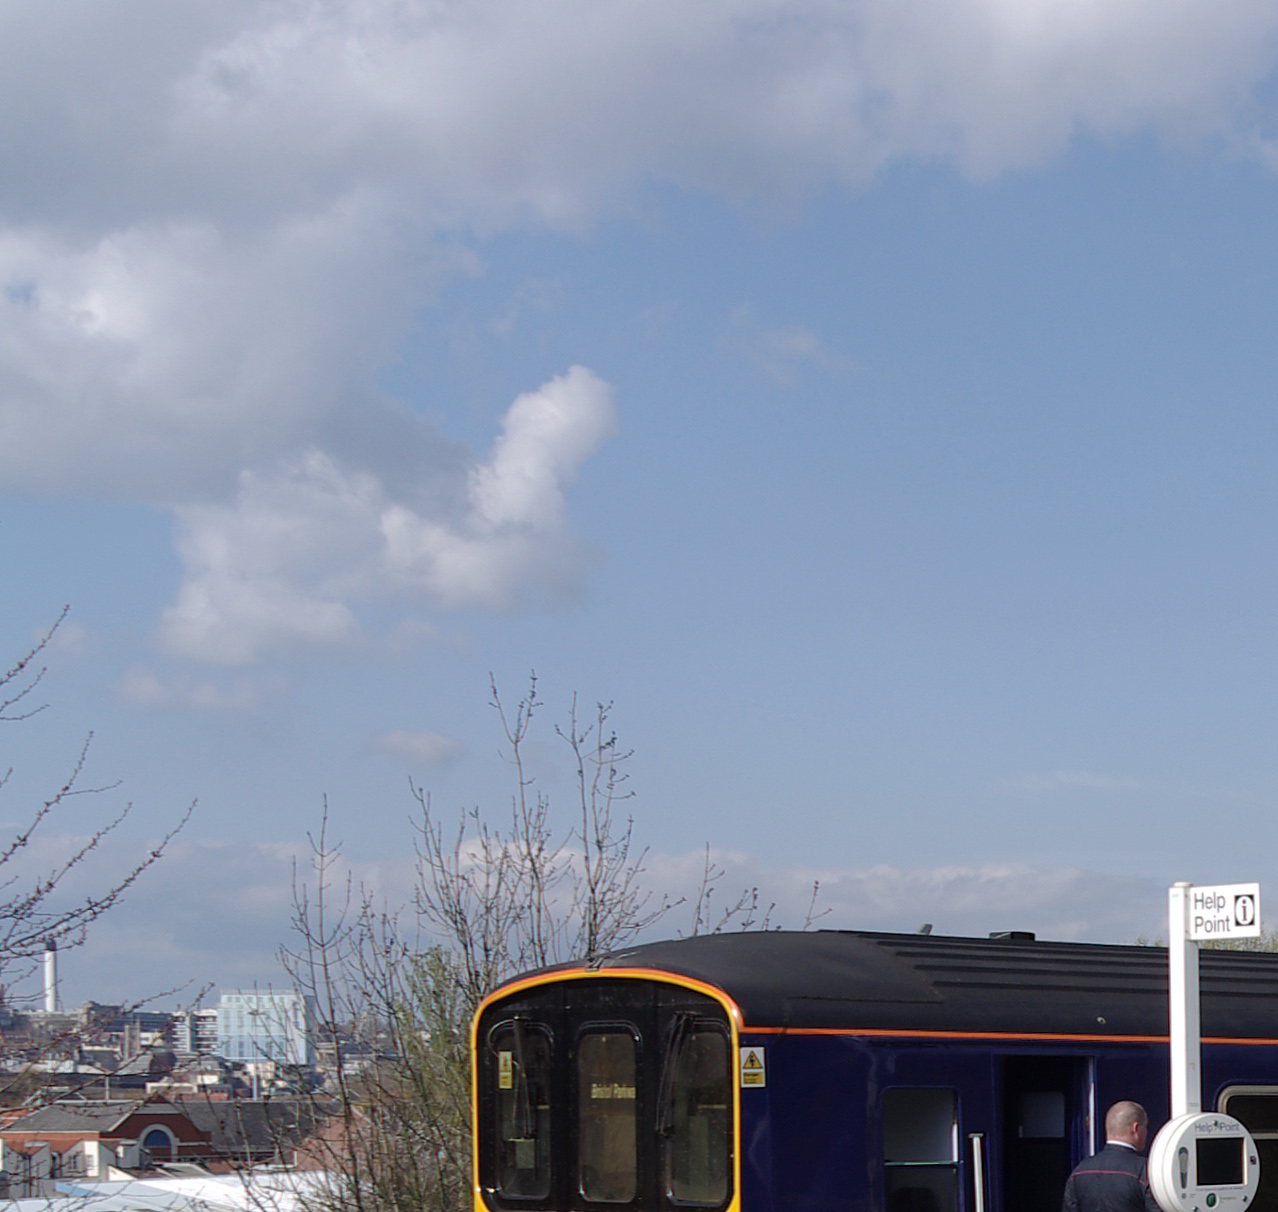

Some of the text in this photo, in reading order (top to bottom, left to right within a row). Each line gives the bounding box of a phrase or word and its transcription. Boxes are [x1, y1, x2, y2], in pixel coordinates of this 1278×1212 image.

[1194, 891, 1226, 913] Help
[1194, 915, 1231, 933] Point
[1194, 1122, 1241, 1133] Help Point
